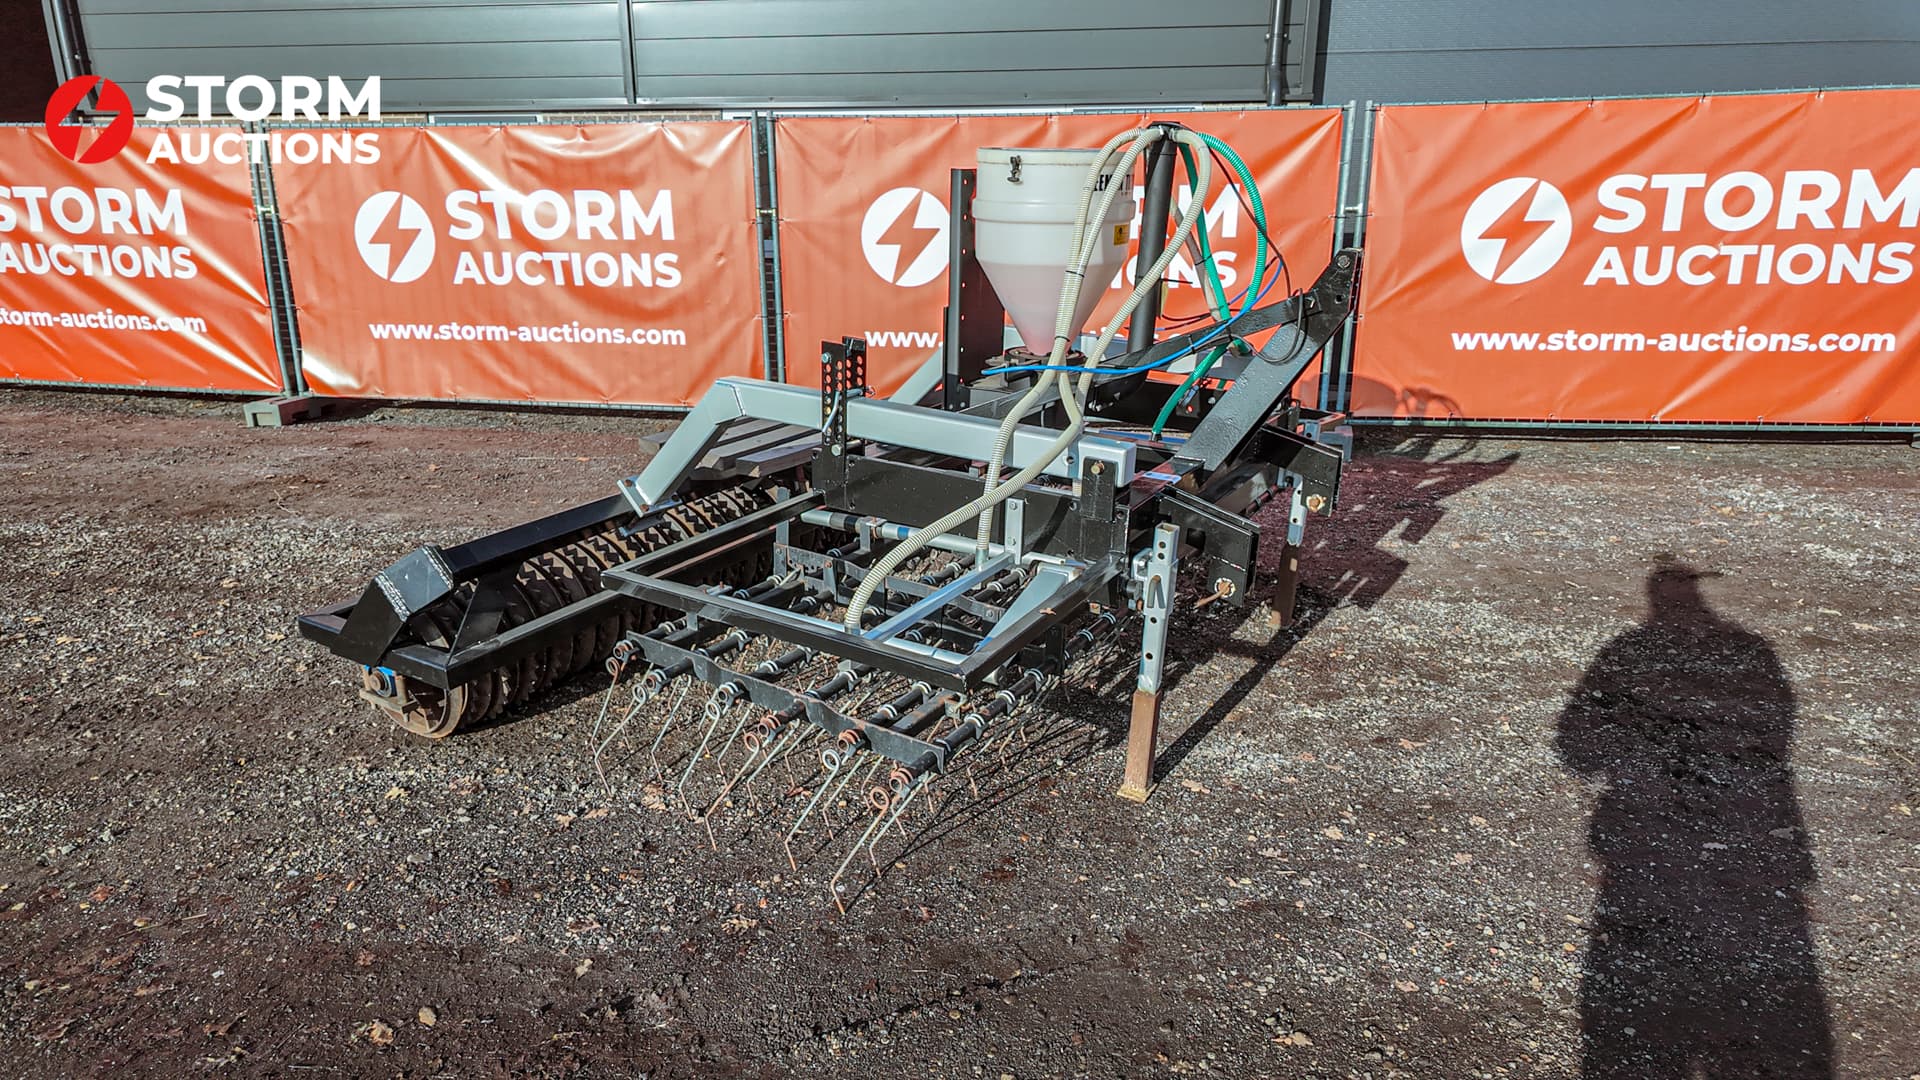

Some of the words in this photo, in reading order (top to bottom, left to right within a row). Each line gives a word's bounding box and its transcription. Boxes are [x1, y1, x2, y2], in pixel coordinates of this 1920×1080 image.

[445, 189, 675, 241] STORM
[1592, 167, 1920, 234] STORM
[0, 242, 198, 279] AUCTIONS
[453, 251, 683, 288] AUCTIONS
[1583, 242, 1916, 286] AUCTIONS
[368, 322, 686, 346] www.storm-auctions.com
[1451, 326, 1896, 352] www.storm-auctions.com
